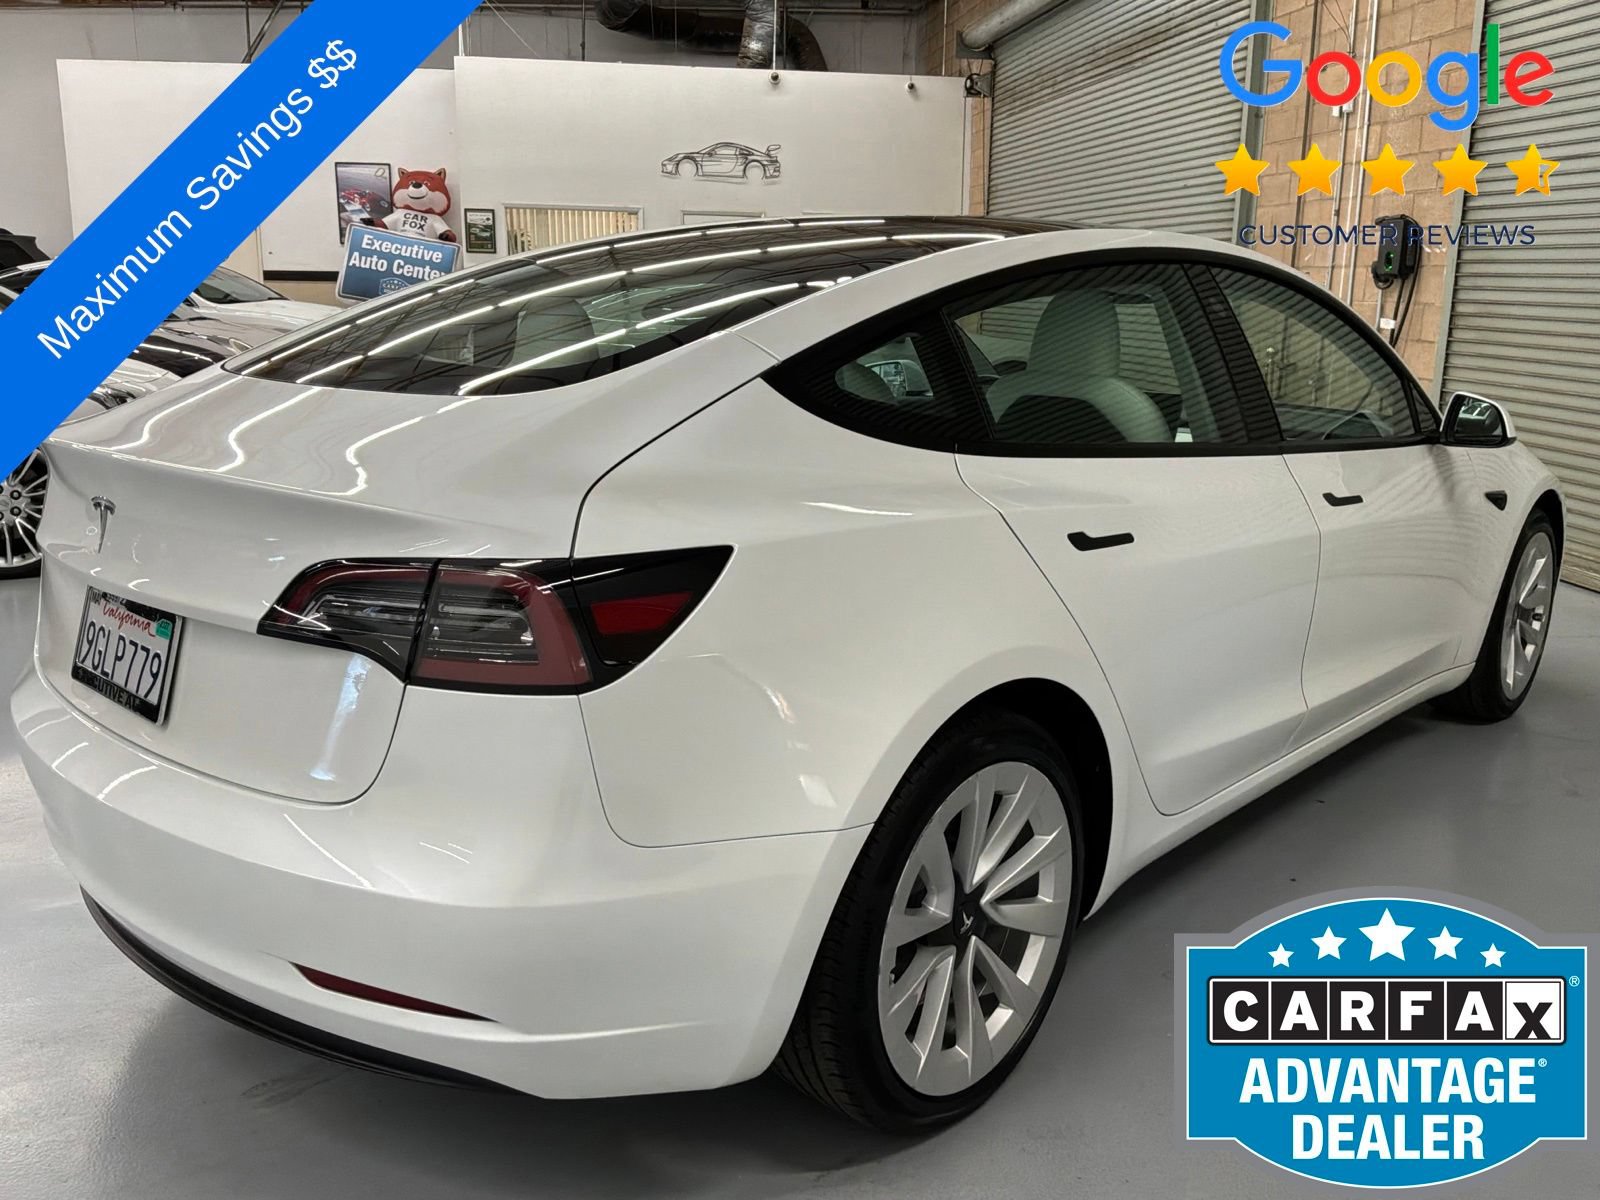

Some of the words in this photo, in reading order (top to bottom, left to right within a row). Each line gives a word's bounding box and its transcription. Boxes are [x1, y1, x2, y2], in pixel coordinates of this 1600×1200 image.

[402, 219, 425, 232] FOX
[403, 212, 428, 224] CAR
[361, 234, 443, 263] Executive
[348, 252, 388, 272] Auto
[80, 620, 163, 699] 9GLP779
